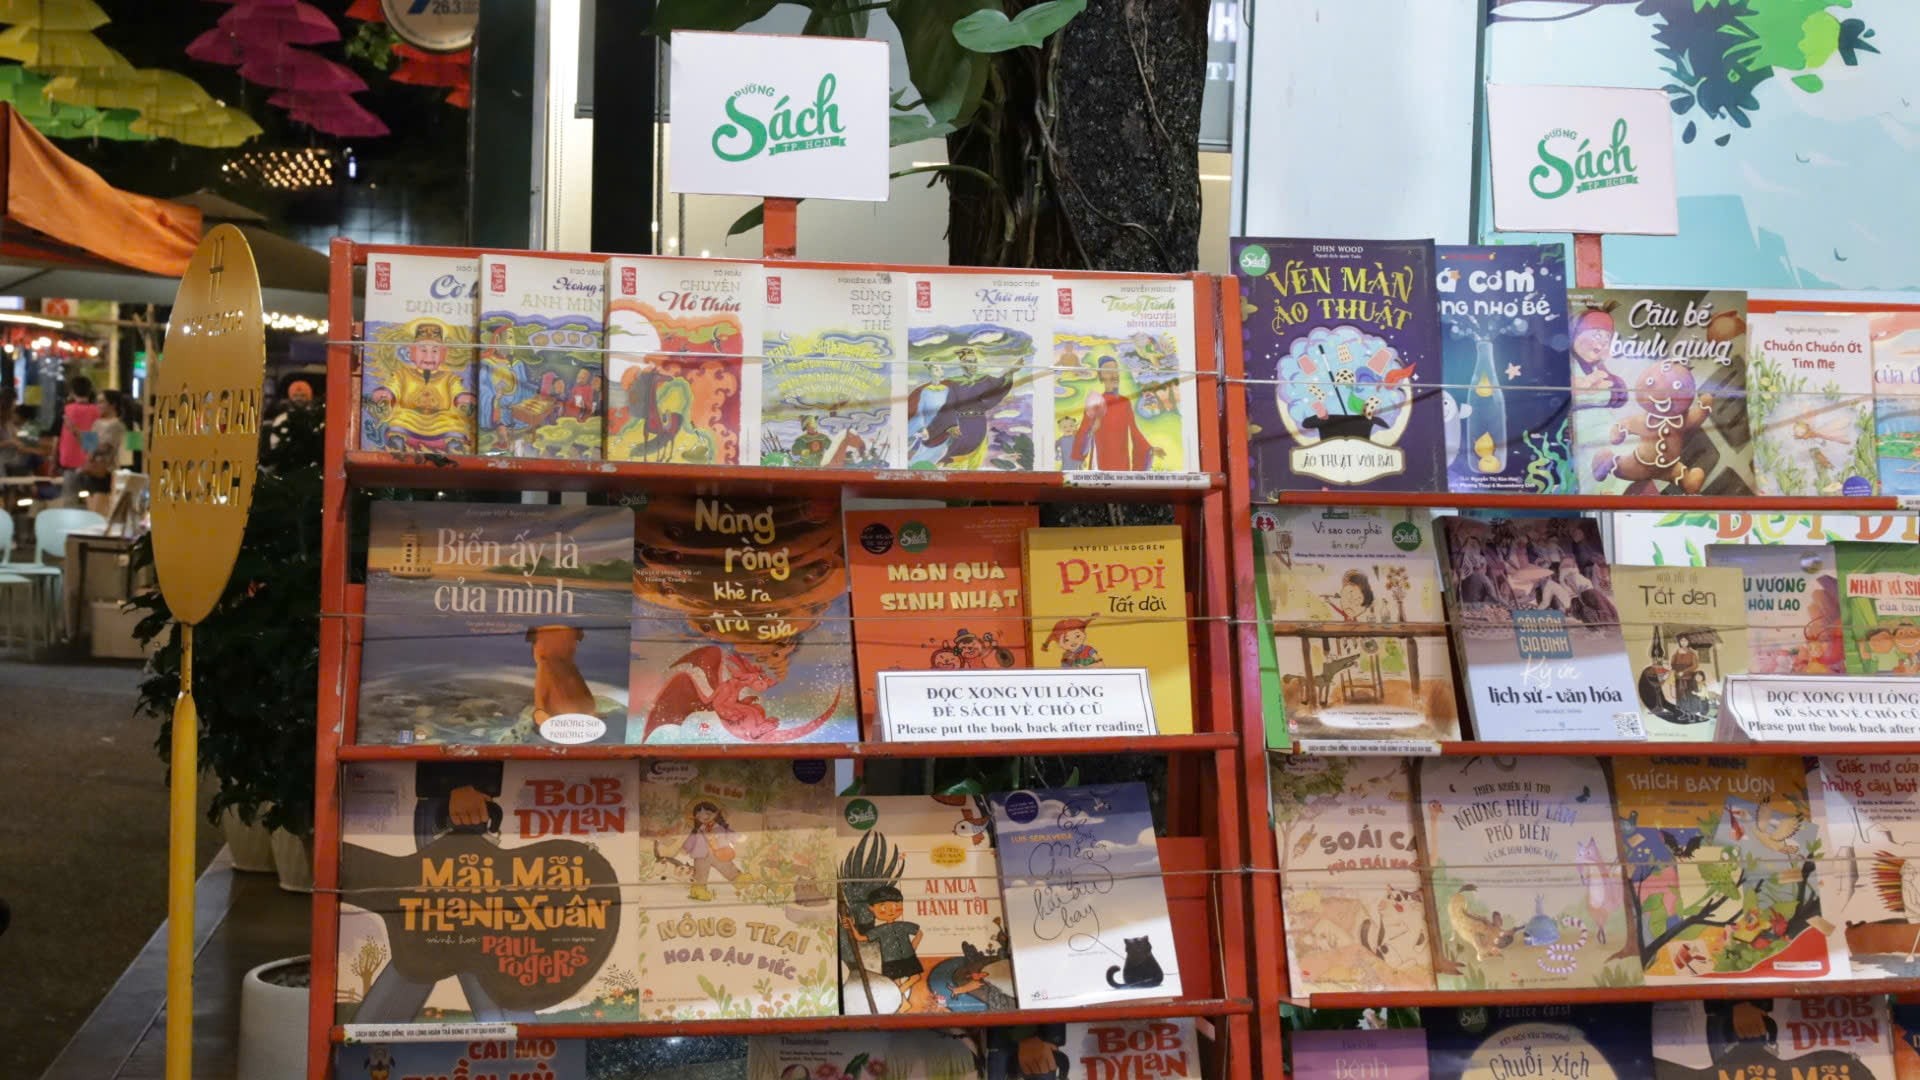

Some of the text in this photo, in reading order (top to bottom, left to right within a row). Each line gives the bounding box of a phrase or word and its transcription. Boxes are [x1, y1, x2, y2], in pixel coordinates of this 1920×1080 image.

[734, 83, 775, 97] ĐƯỜNG
[711, 73, 846, 162] Sách
[805, 138, 831, 149] HCM
[1529, 118, 1638, 199] Sách
[1605, 178, 1628, 187] HCM
[1312, 244, 1364, 254] JOHN WOOD
[1265, 259, 1331, 298] VÉN
[1341, 262, 1415, 304] MÀN
[520, 294, 562, 310] ANH
[1316, 298, 1413, 331] THUẬT
[1628, 299, 1714, 330] Cậu bé
[1609, 332, 1668, 359] bánh
[1817, 358, 1836, 372] Mẹ
[216, 388, 261, 434] GIAN
[695, 498, 776, 545] Nàng
[1328, 527, 1343, 535] sao
[1345, 527, 1362, 535] con
[435, 526, 579, 577] Biển ấy là
[724, 537, 791, 581] rồng
[887, 562, 947, 582] MÓN
[1056, 558, 1166, 594] Pippi
[713, 581, 772, 602] khè ra
[1756, 574, 1806, 593] VƯƠNG
[434, 577, 575, 615] của mình
[880, 589, 1019, 612] SINH NHẬT
[1108, 595, 1167, 613] Tất dài
[1748, 594, 1801, 611] HÒN LAO
[1520, 637, 1542, 653] GIA
[926, 683, 1104, 702] ĐỌC XONG VUI LÒNG
[1488, 686, 1520, 707] lịch
[1523, 687, 1543, 704] sử
[1555, 688, 1587, 704] văn
[1589, 686, 1623, 705] hóa
[1767, 690, 1919, 706] ĐỌC XONG VUI LÒNG
[960, 703, 1006, 717] SÁCH
[1079, 702, 1103, 716] CŨ
[897, 721, 1144, 737] Please put the book back after reading
[1748, 721, 1915, 734] Please put the book back after
[1895, 757, 1919, 774] của
[524, 776, 624, 807] BOB
[1626, 767, 1775, 795] THÍCH BAY LƯỢN
[1867, 778, 1892, 796] cây
[1893, 777, 1918, 793] bút
[1320, 824, 1383, 855] SOÁI
[415, 853, 592, 894] Mãi Mãi
[925, 878, 977, 894] AI MUA
[657, 911, 811, 956] NÔNG TRẠI
[664, 946, 798, 981] HOA ĐẬU BIẾC
[1801, 995, 1874, 1019] BOB
[1088, 1023, 1183, 1054] BOB
[1489, 1046, 1590, 1080] Chuỗi xích
